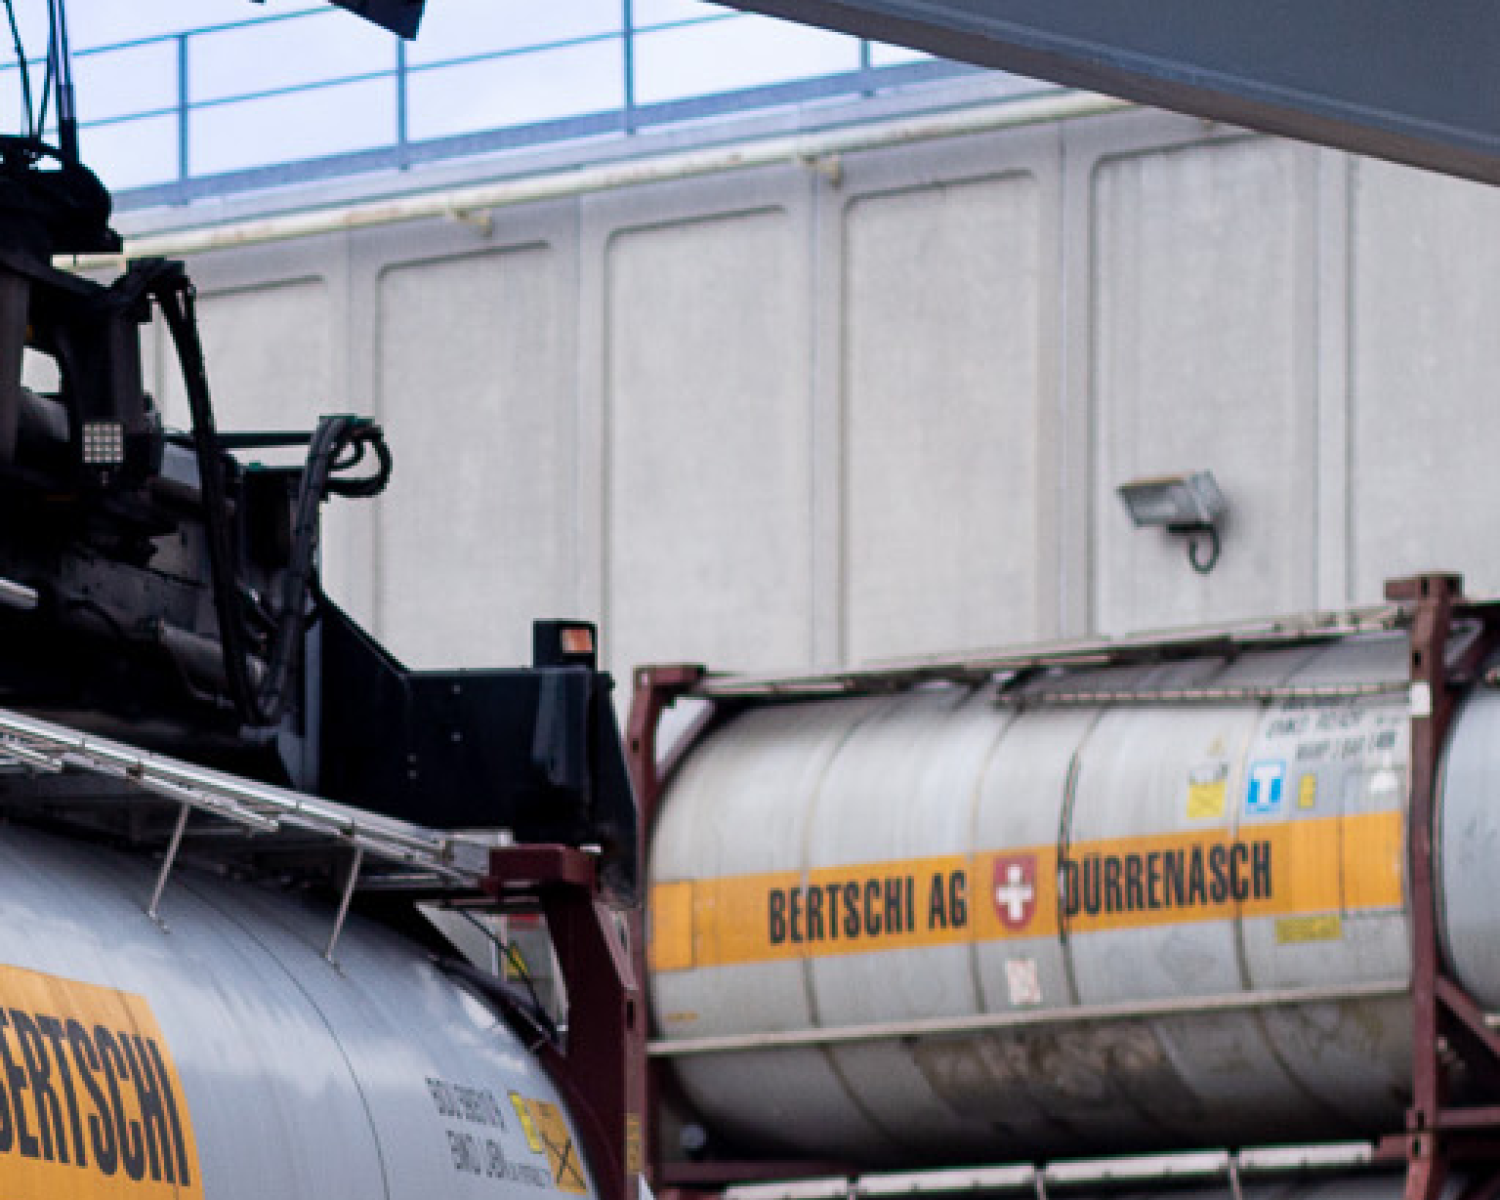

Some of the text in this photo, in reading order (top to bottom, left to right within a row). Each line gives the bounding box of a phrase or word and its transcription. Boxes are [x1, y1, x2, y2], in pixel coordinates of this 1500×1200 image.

[767, 838, 1274, 948] BERTSCHI AG DÜRRENASCH
